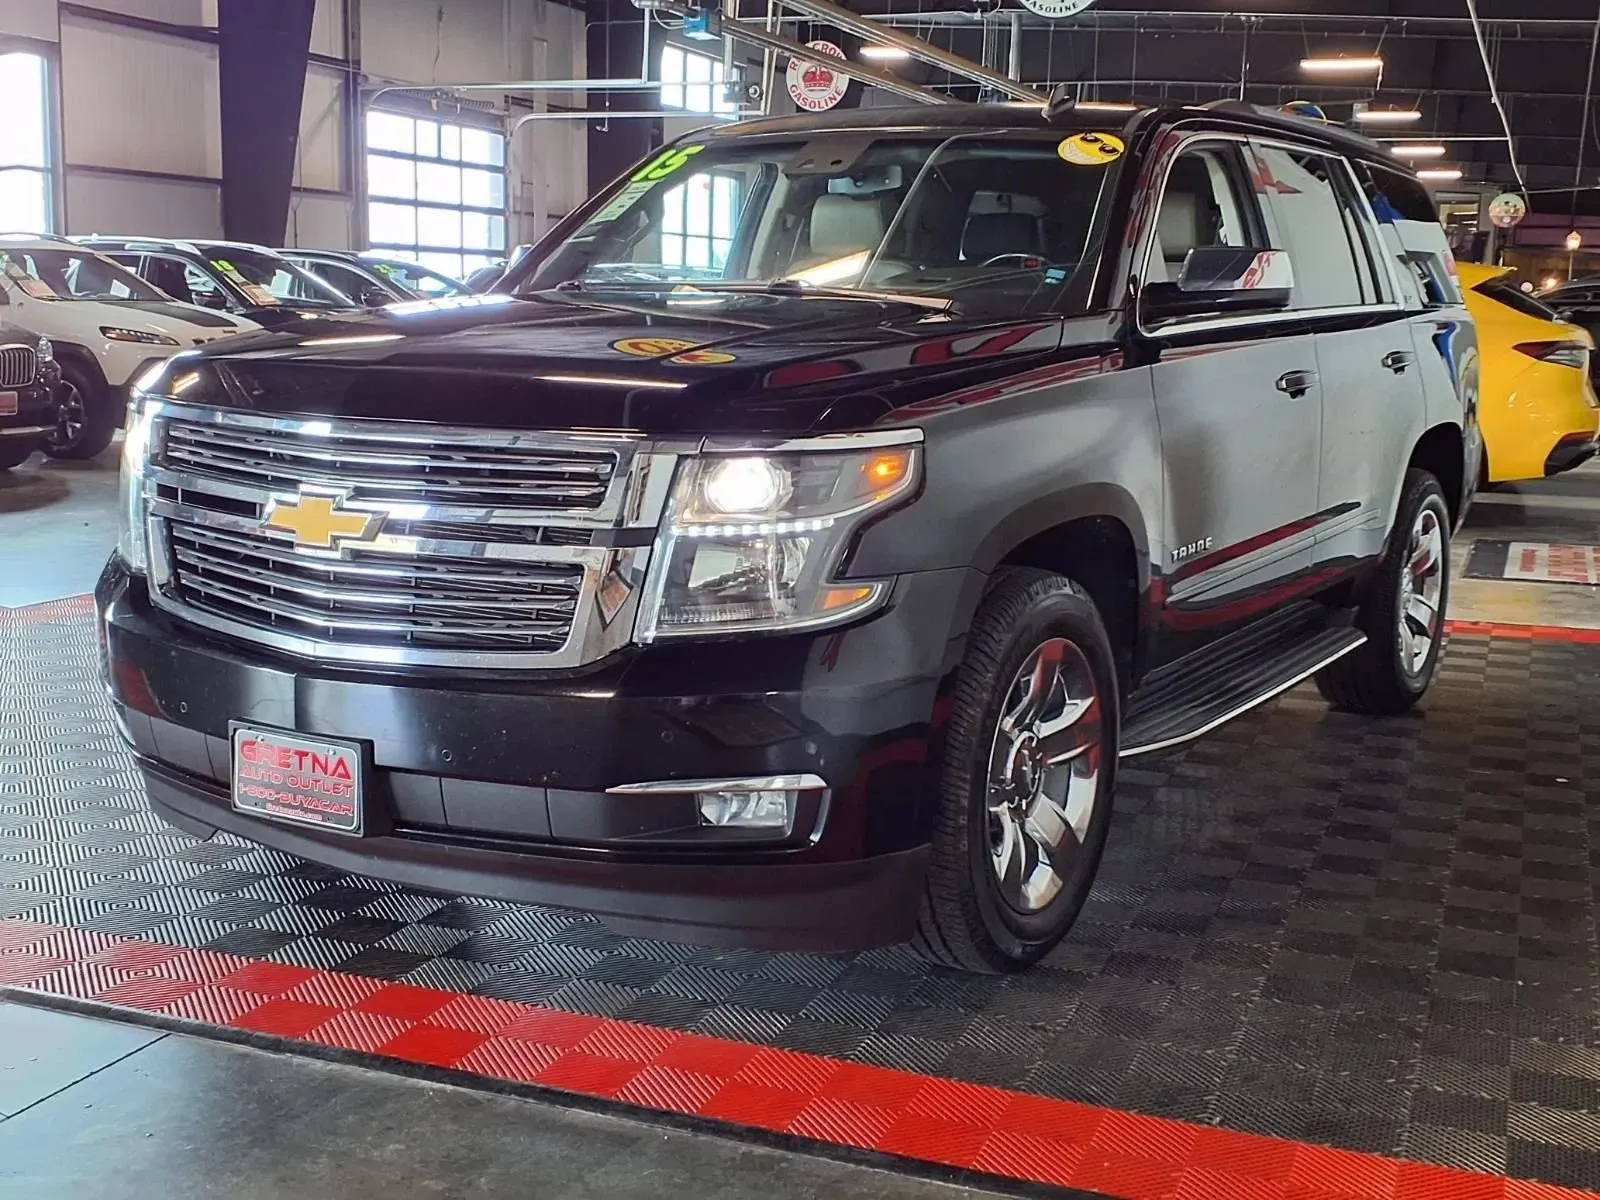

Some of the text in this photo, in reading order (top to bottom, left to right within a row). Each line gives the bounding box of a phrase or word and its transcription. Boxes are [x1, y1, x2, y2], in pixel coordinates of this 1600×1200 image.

[1026, 0, 1079, 13] ASOLINE
[790, 84, 843, 109] GASOLINE
[1171, 536, 1212, 561] TAHOE
[240, 739, 353, 782] GRETNA
[240, 765, 354, 798] AUTO OUTLET
[239, 782, 354, 817] 1-800-BUYACAR
